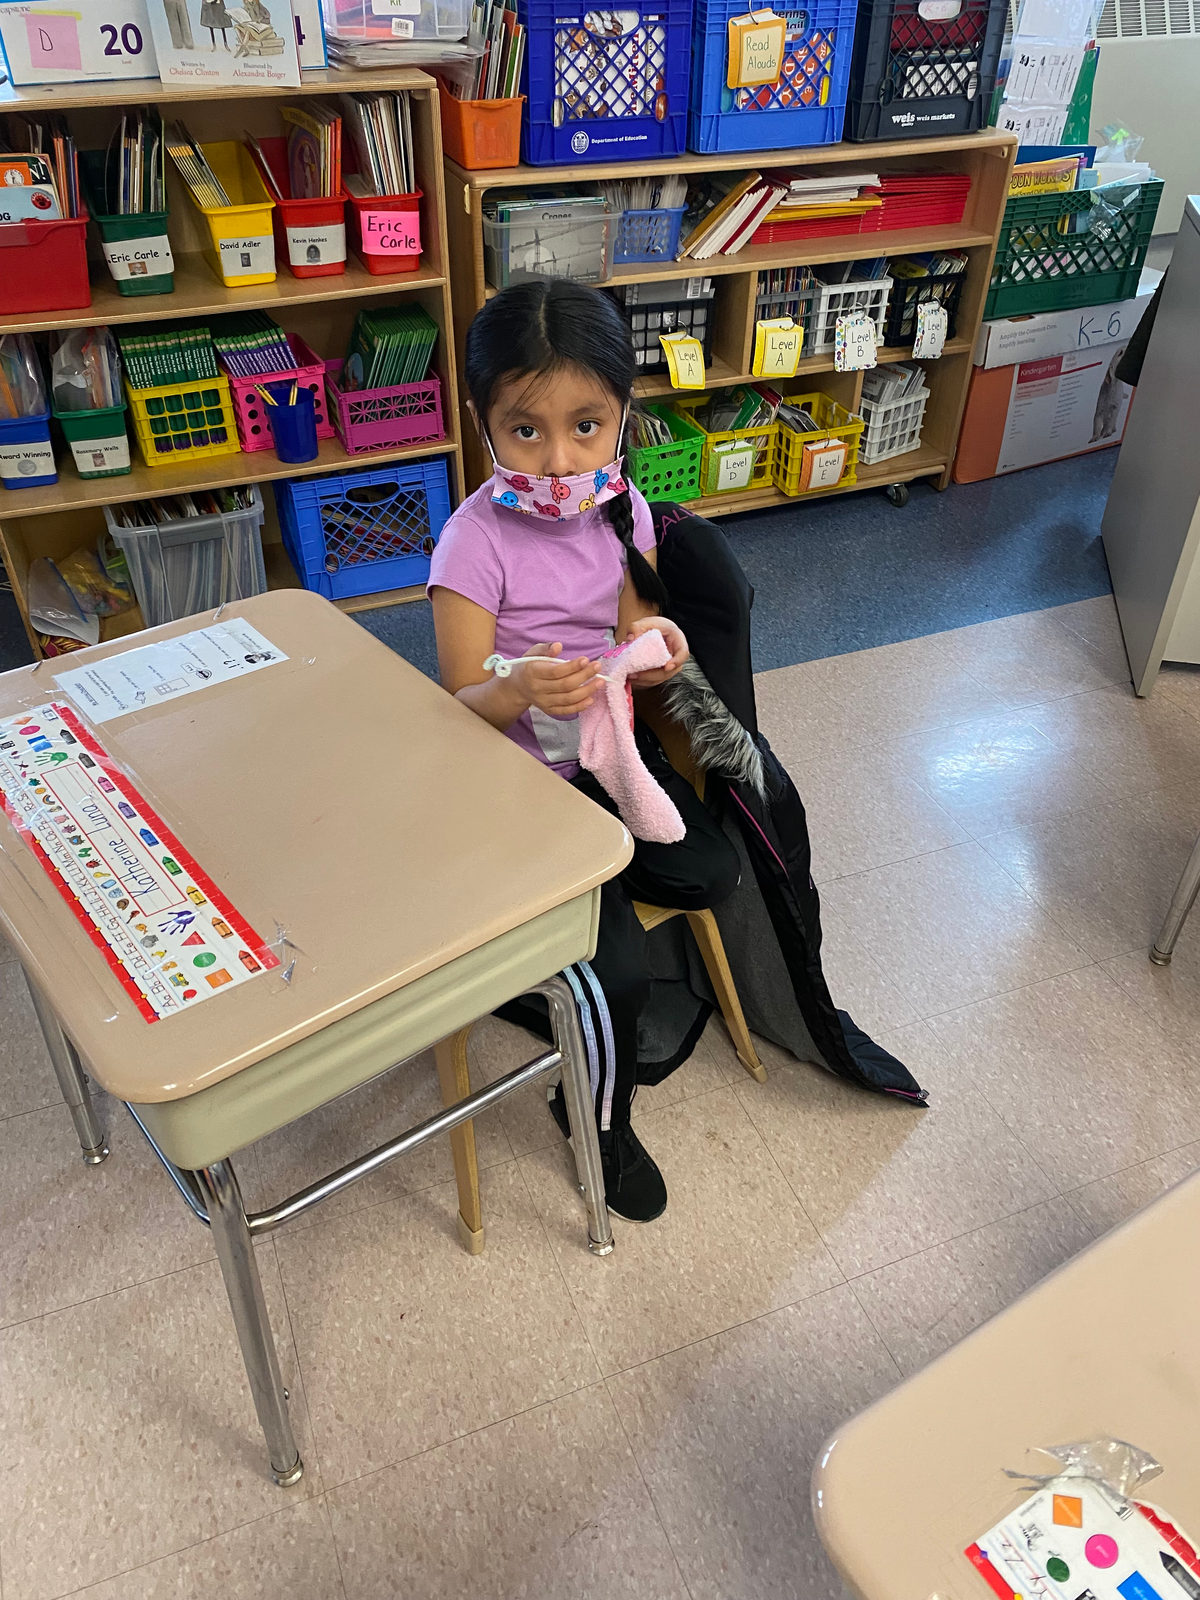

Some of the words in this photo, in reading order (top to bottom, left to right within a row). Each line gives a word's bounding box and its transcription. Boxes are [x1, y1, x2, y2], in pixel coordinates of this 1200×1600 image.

[38, 28, 53, 51] D
[100, 23, 143, 55] 20
[746, 34, 770, 52] Read
[747, 56, 777, 70] Alouds
[892, 112, 915, 124] weis
[624, 134, 648, 142] Education
[367, 215, 403, 233] Eric
[220, 242, 240, 250] David
[242, 241, 261, 249] Adler
[380, 235, 417, 249] Carle
[110, 254, 131, 264] Eric
[134, 250, 160, 261] Carle
[927, 317, 942, 331] Level
[1078, 310, 1121, 346] K-6
[771, 335, 797, 350] Level
[851, 330, 871, 344] Level
[930, 333, 936, 345] B
[678, 348, 699, 362] Level
[857, 345, 865, 357] B
[776, 352, 784, 366] A
[687, 363, 694, 377] A
[1020, 364, 1058, 377] Kindergarten
[22, 451, 51, 459] Winning
[76, 448, 102, 456] Rosemary
[726, 457, 747, 470] Level
[818, 455, 840, 468] Level
[729, 471, 737, 481] D
[821, 469, 828, 480] E
[82, 803, 112, 836] Luna
[108, 838, 160, 898] Katherine
[162, 994, 176, 1008] Aa
